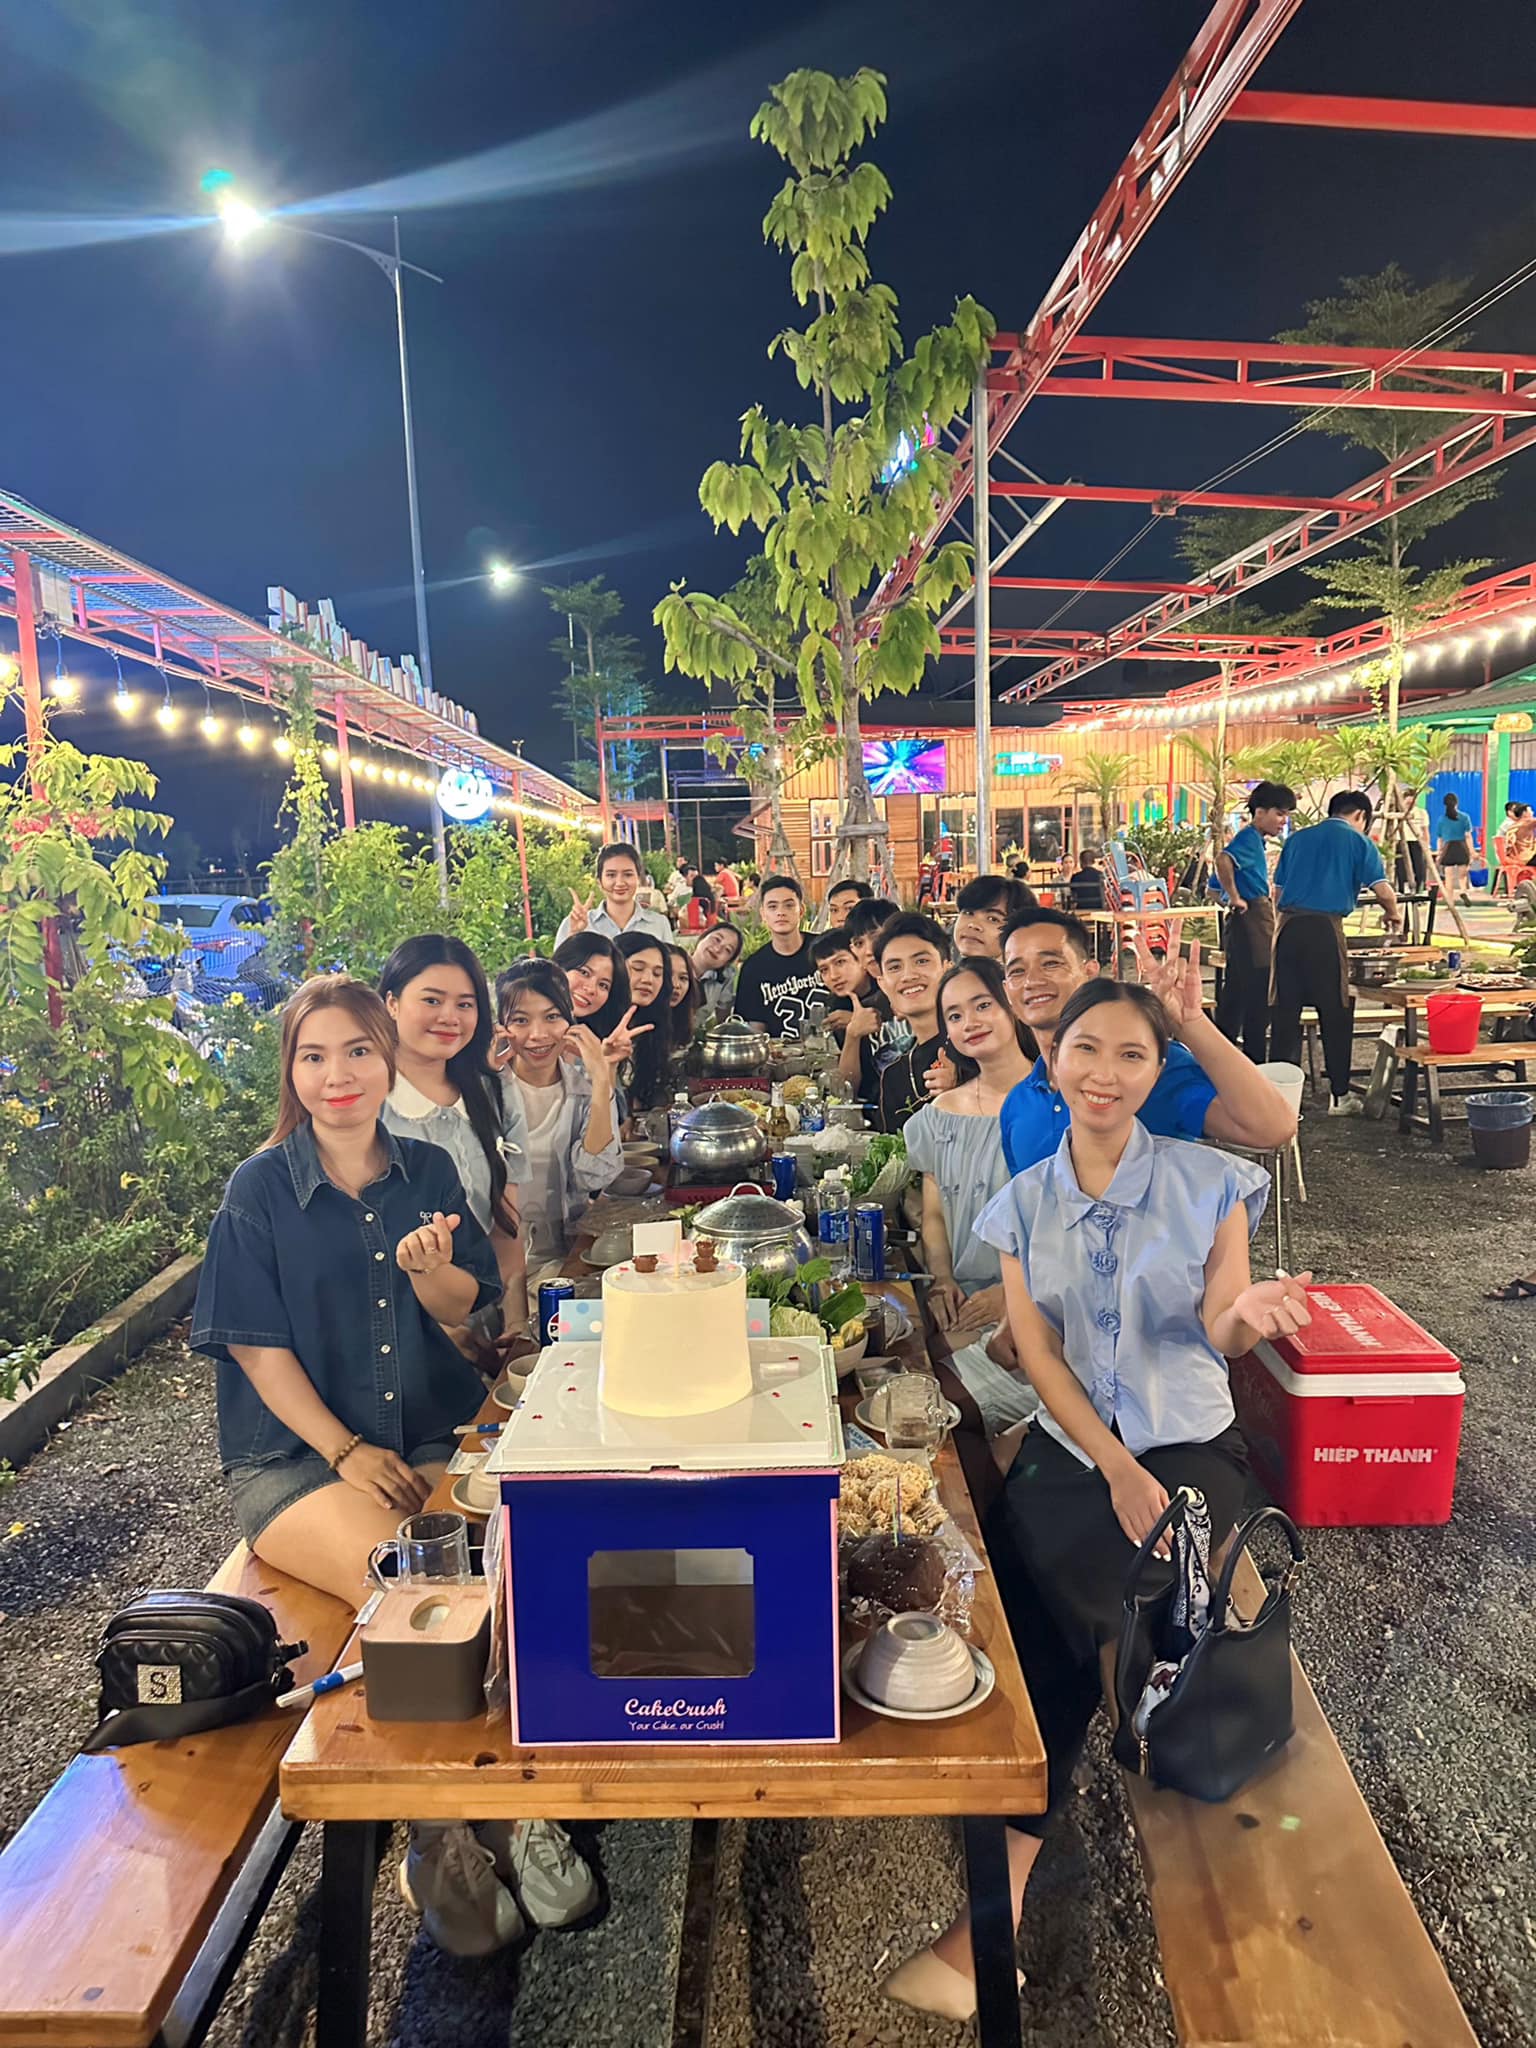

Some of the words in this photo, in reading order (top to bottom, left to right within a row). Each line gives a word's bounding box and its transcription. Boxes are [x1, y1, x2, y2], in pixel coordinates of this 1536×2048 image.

[150, 1671, 168, 1699] S
[624, 1697, 728, 1717] CakeCrush
[628, 1720, 651, 1731] Your
